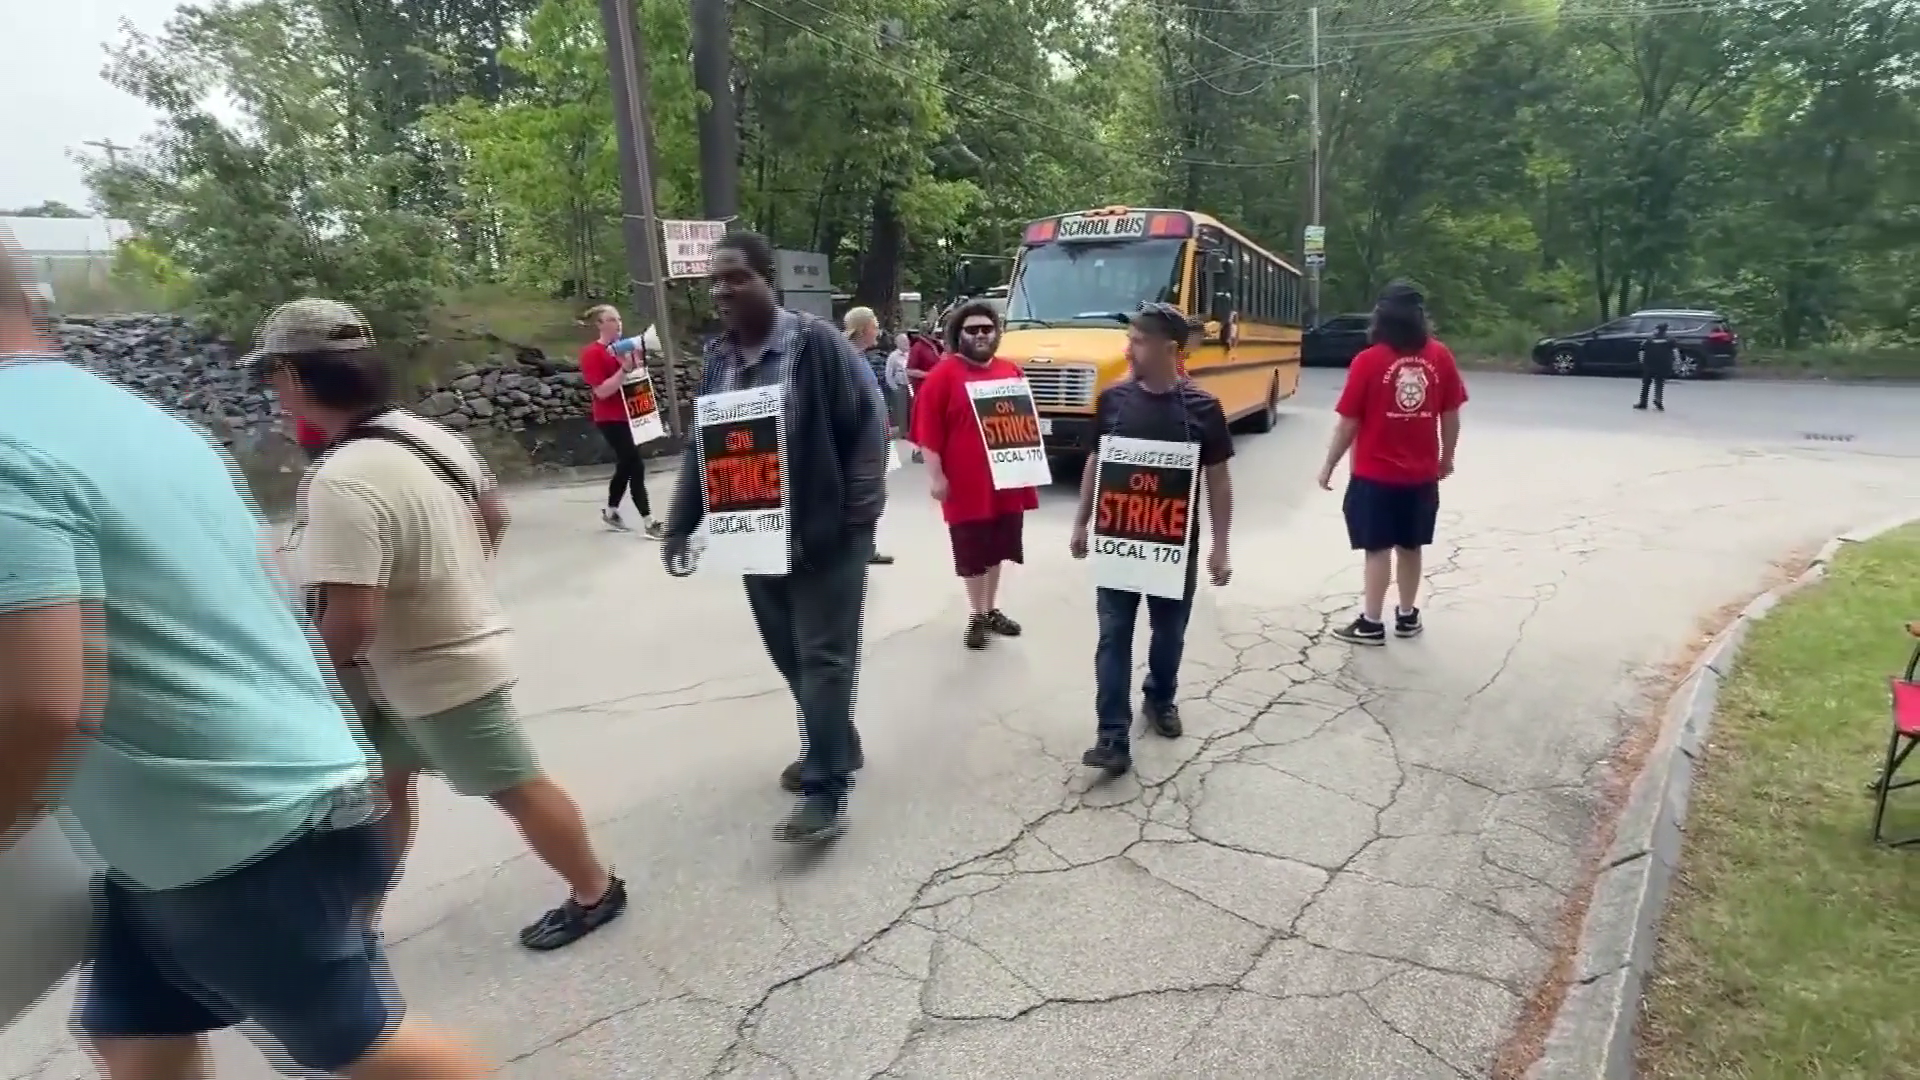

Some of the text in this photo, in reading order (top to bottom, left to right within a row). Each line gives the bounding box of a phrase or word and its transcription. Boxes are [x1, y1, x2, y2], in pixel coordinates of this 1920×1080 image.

[1060, 218, 1143, 236] SCHOOL BUS
[974, 384, 1029, 396] TEMSTE
[702, 397, 778, 421] TEAMSTERS
[996, 401, 1015, 413] ON
[726, 429, 754, 452] ON
[982, 415, 1039, 445] STRIKE
[992, 448, 1043, 463] LOCAL 170
[1106, 447, 1194, 467] TEAMSTERS
[705, 453, 781, 505] STRIKE
[1130, 473, 1158, 492] ON
[709, 513, 784, 535] LOCAL 170
[1098, 491, 1187, 537] STRIKE
[1095, 538, 1181, 565] LOCAL 170
